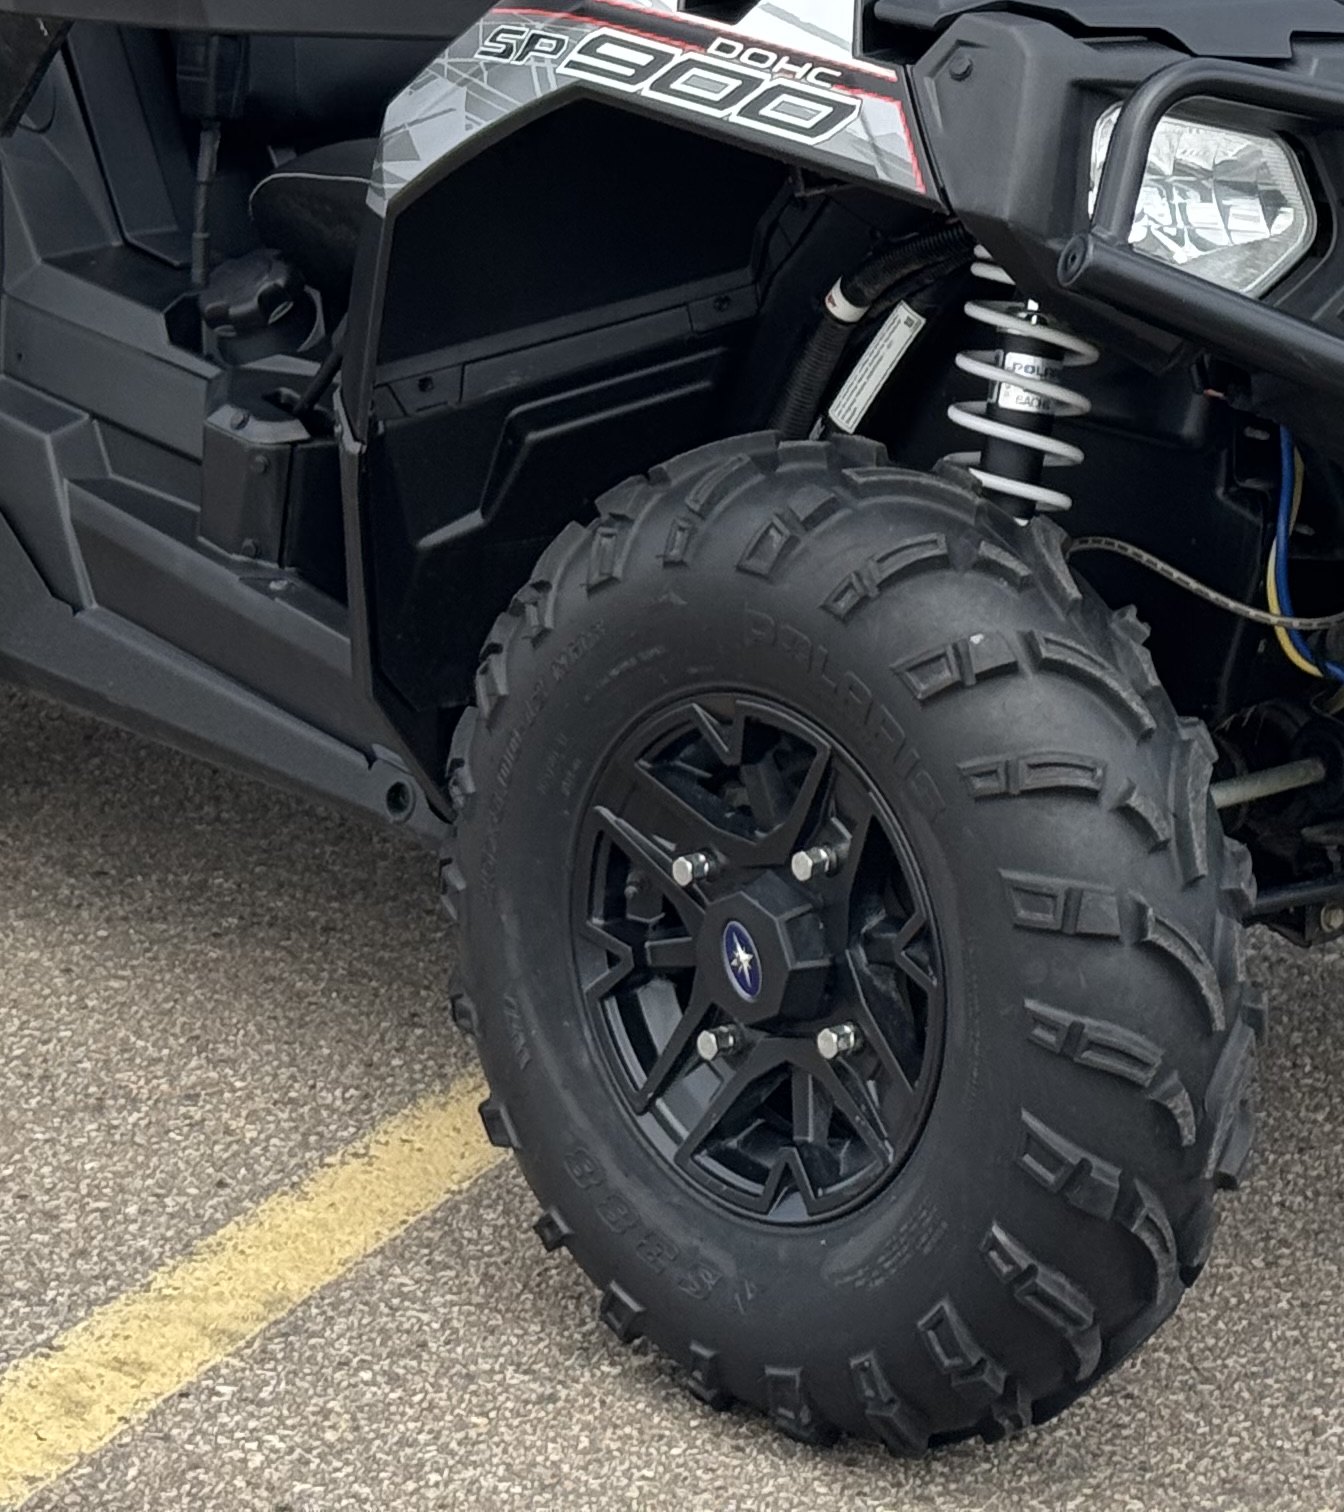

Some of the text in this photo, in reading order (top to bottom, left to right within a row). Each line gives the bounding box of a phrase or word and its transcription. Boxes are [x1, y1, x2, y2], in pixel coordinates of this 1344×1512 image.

[474, 24, 864, 147] SP 900
[705, 35, 843, 89] DOHC
